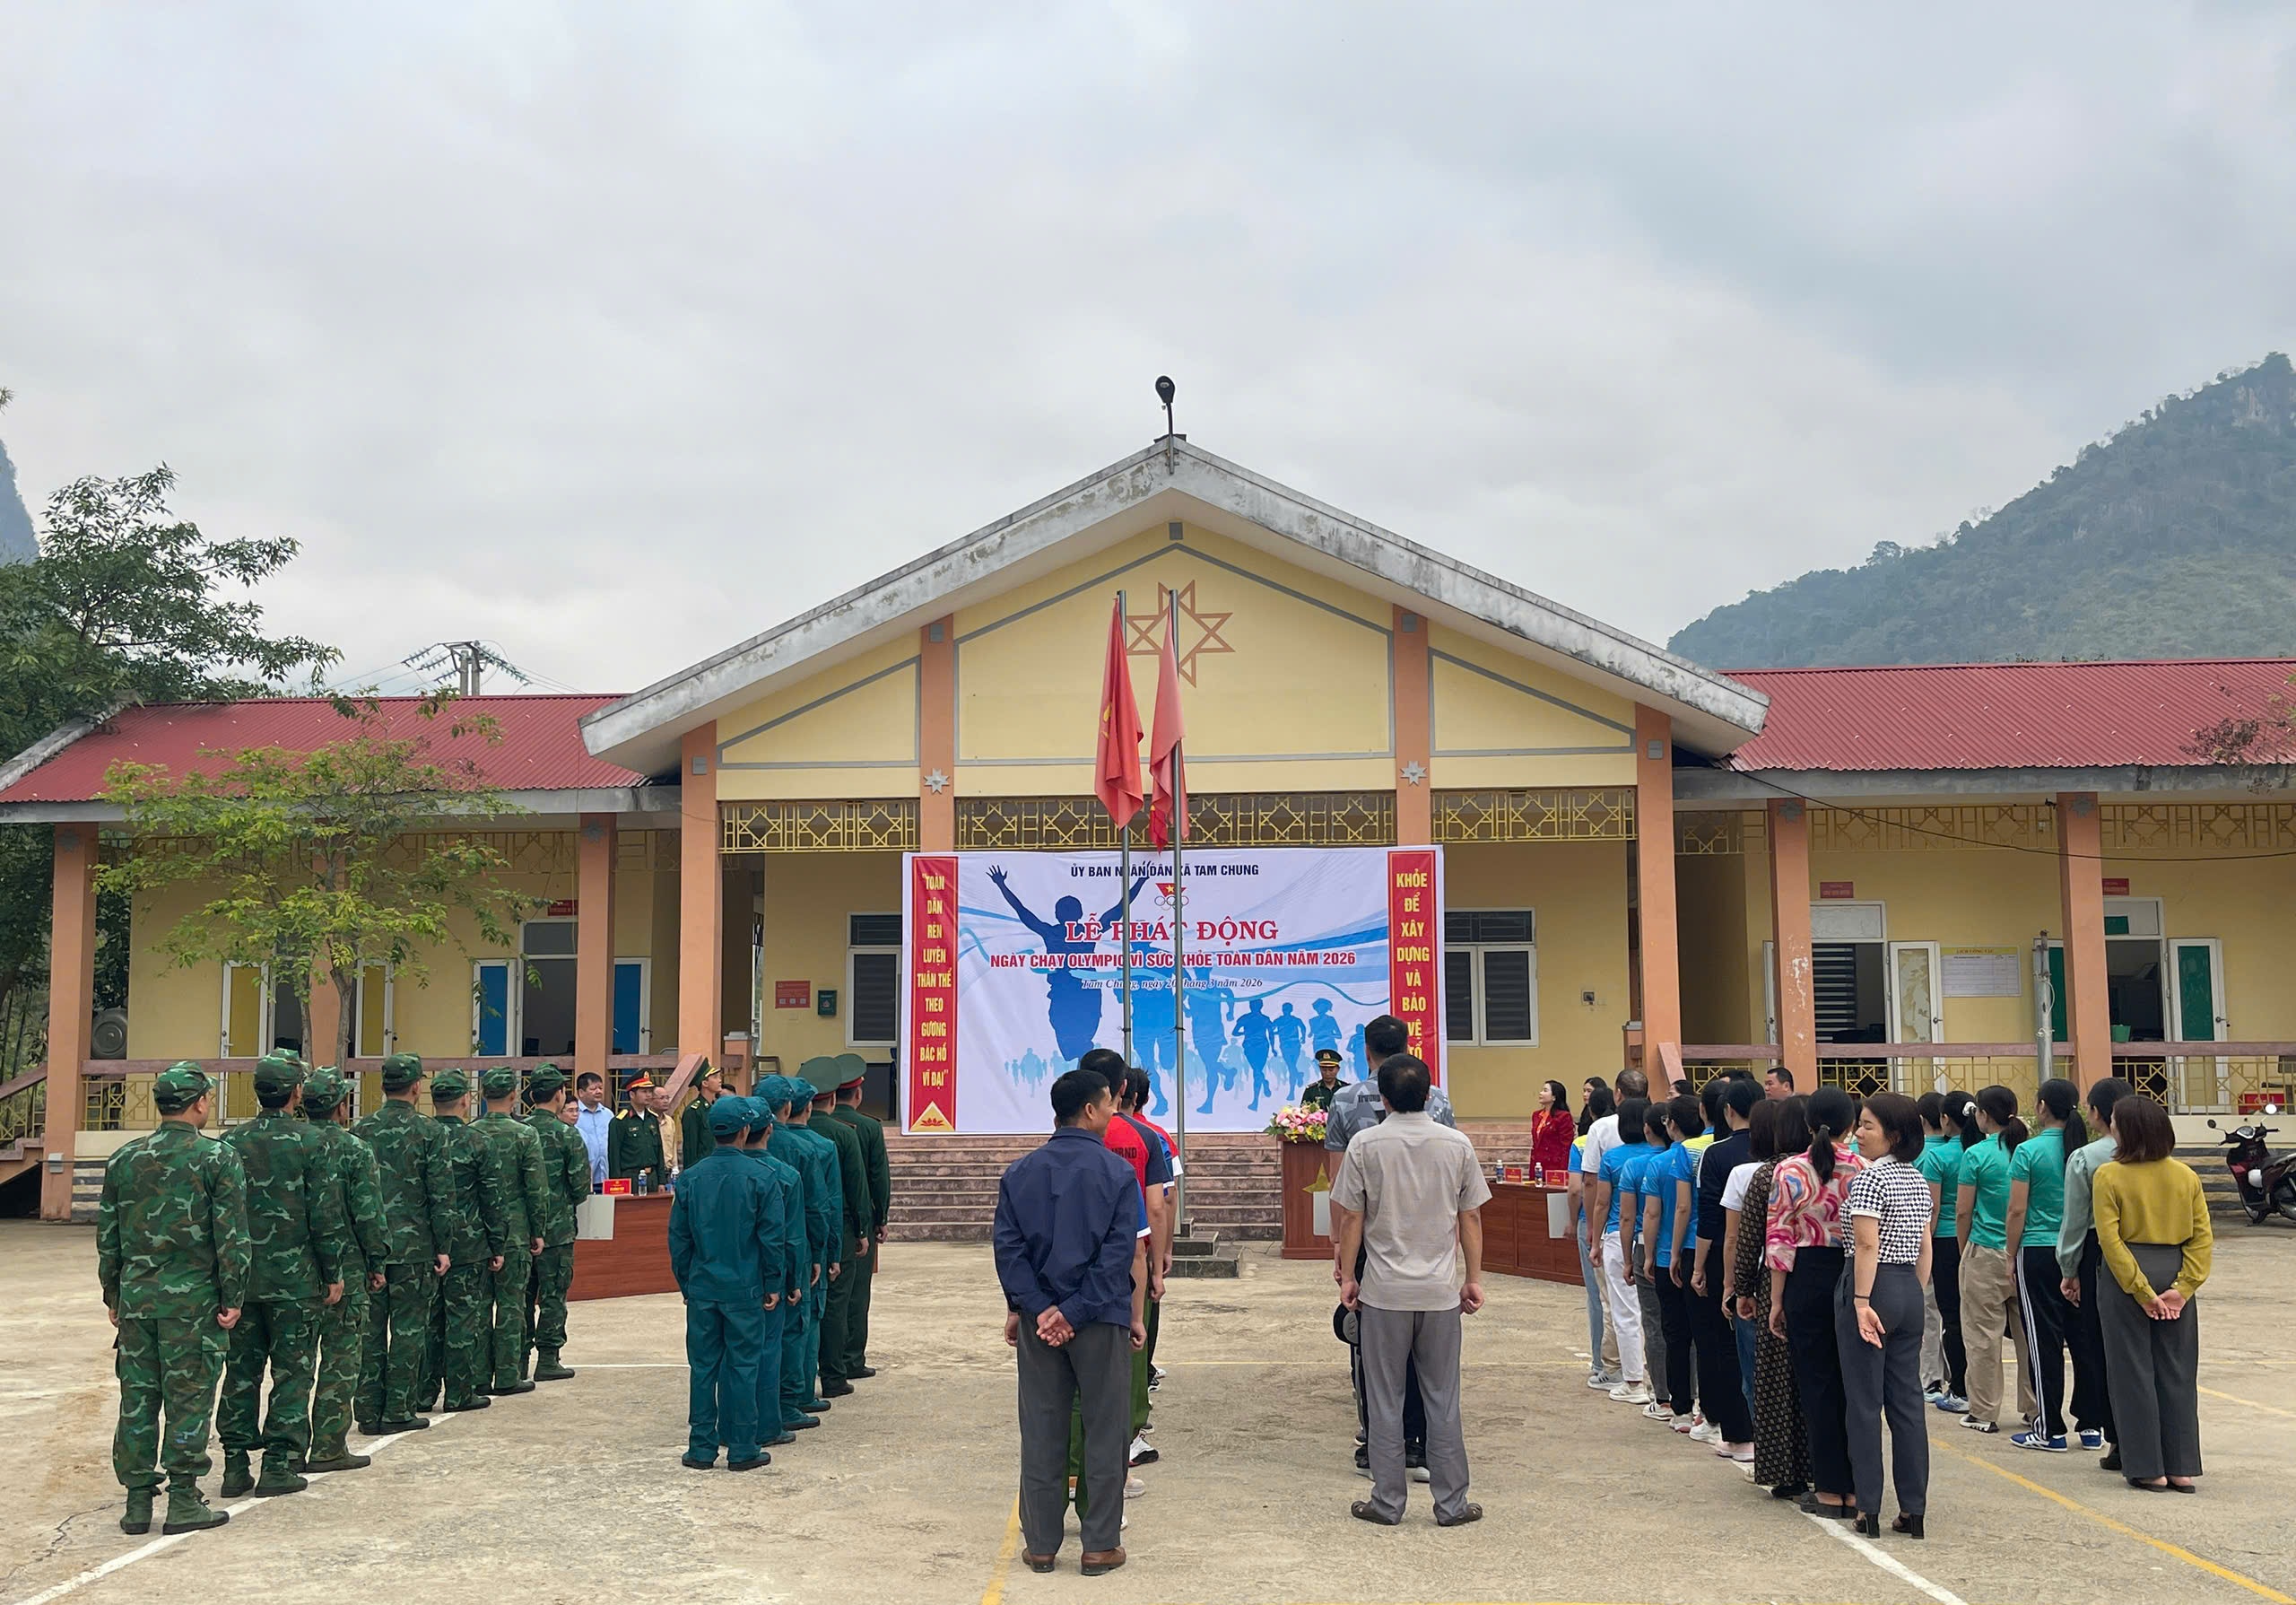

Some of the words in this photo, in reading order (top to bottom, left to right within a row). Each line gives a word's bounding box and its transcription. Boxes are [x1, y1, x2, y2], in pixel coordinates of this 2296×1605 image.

[1071, 863, 1084, 877] ỦY
[1088, 866, 1111, 877] BAN
[1115, 863, 1145, 877] NÂN
[1150, 863, 1172, 877] DÂN
[1194, 865, 1217, 876] TAM
[1221, 864, 1259, 876] CHUNG
[1396, 868, 1428, 888] KHỎE
[927, 897, 943, 914] DÂN
[1405, 892, 1421, 912] ĐỂ
[1065, 912, 1102, 941] LỄ
[1196, 915, 1279, 946] ĐỘNG
[1401, 920, 1424, 938] XÂY
[923, 945, 946, 966] LUYỆN
[990, 952, 1026, 968] NGÀY
[1031, 955, 1064, 971] CHẠY
[1069, 954, 1124, 967] OLYMPIC
[1130, 951, 1143, 966] VÌ
[1146, 950, 1173, 966] SỨC
[1216, 950, 1251, 966] TOÀN
[1256, 951, 1284, 965] DÂN
[1288, 951, 1318, 965] NĂM
[1323, 952, 1356, 965] 2026
[1396, 945, 1430, 964] DỰNG
[918, 970, 936, 988] THÂN
[1106, 979, 1140, 990] Chg,
[1183, 978, 1206, 990] háng
[1218, 979, 1237, 987] năm
[1240, 978, 1263, 987] 2026
[1405, 968, 1422, 987] VÀ
[926, 997, 944, 1012] THEO
[1402, 991, 1426, 1012] BẢO
[921, 1020, 947, 1036] GƯƠNG
[1407, 1018, 1422, 1040] VỆ
[919, 1043, 935, 1062] BÁC
